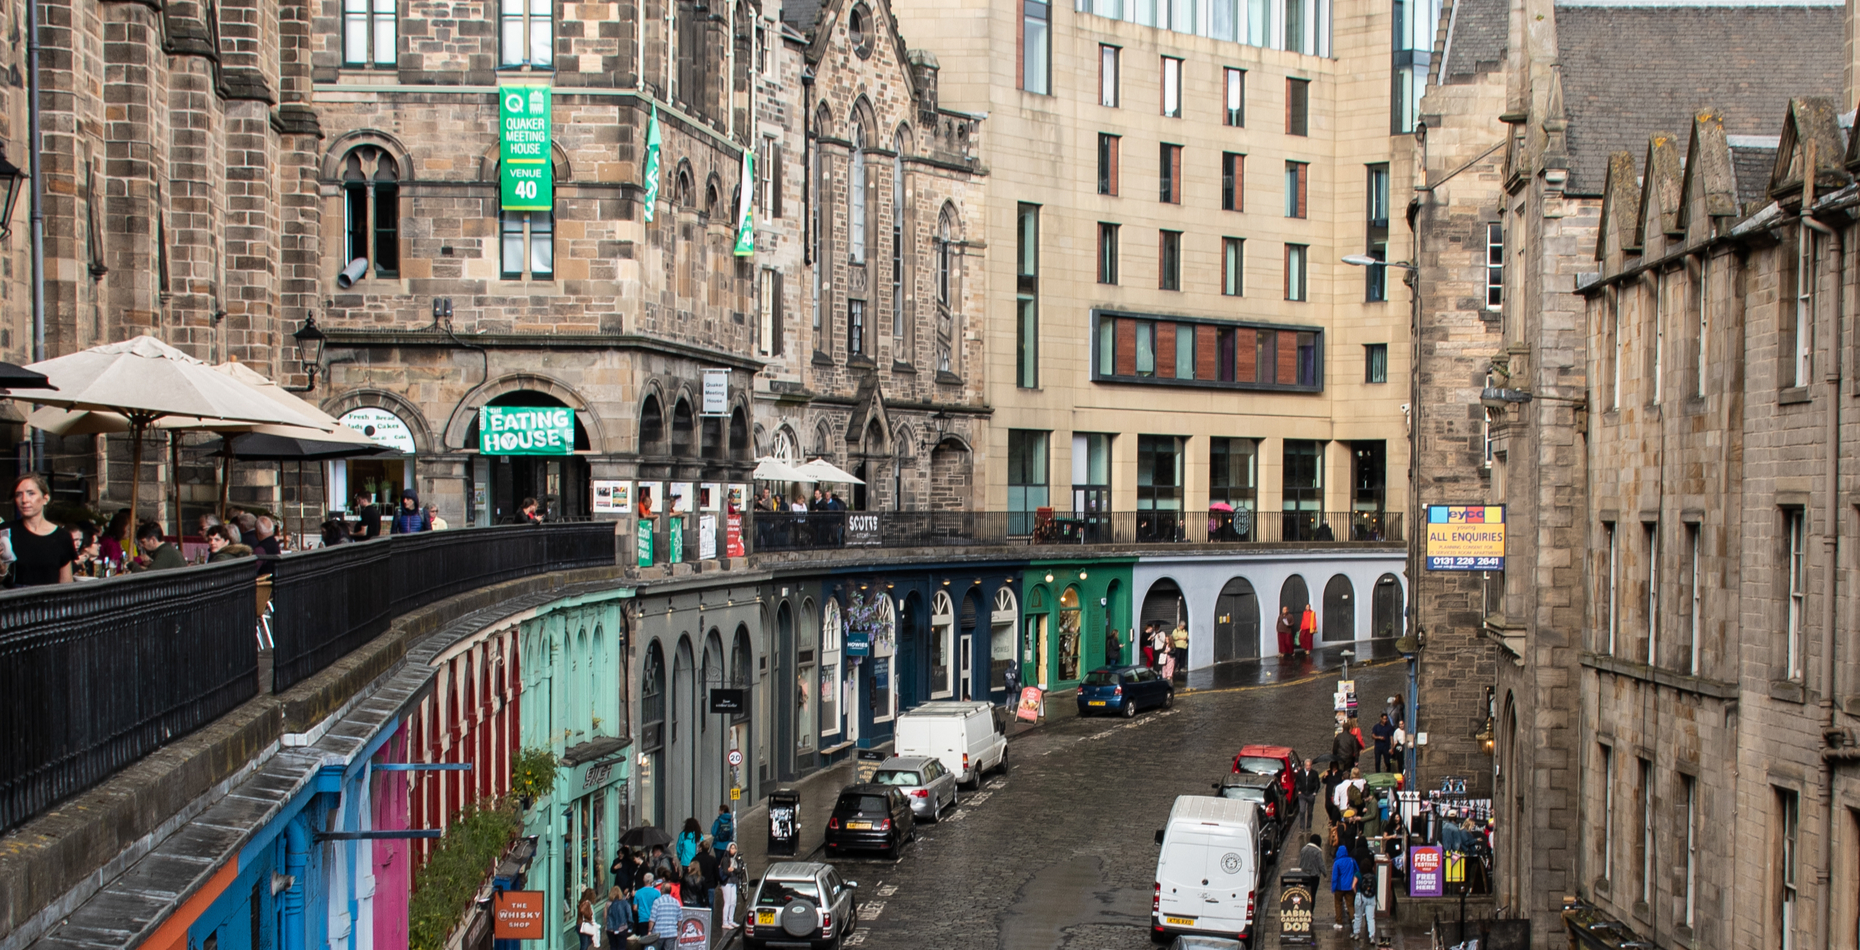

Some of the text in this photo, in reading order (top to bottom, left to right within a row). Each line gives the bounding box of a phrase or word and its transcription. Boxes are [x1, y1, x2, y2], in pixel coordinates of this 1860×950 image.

[506, 118, 544, 130] QUAKER
[506, 131, 545, 142] MEETING
[510, 143, 540, 154] HOUSE
[510, 169, 542, 178] VENUE
[515, 180, 537, 199] 40
[490, 410, 568, 431] EATING
[484, 430, 561, 452] HOUSE
[1448, 510, 1485, 520] eyco
[849, 515, 878, 532] SCOTTS
[1430, 532, 1503, 544] ALL ENQUIRIES
[1433, 557, 1454, 565] 0131
[1477, 557, 1499, 565] 2641
[1414, 853, 1438, 862] FREE
[498, 911, 540, 919] WHISKY
[1284, 922, 1310, 932] DOR
